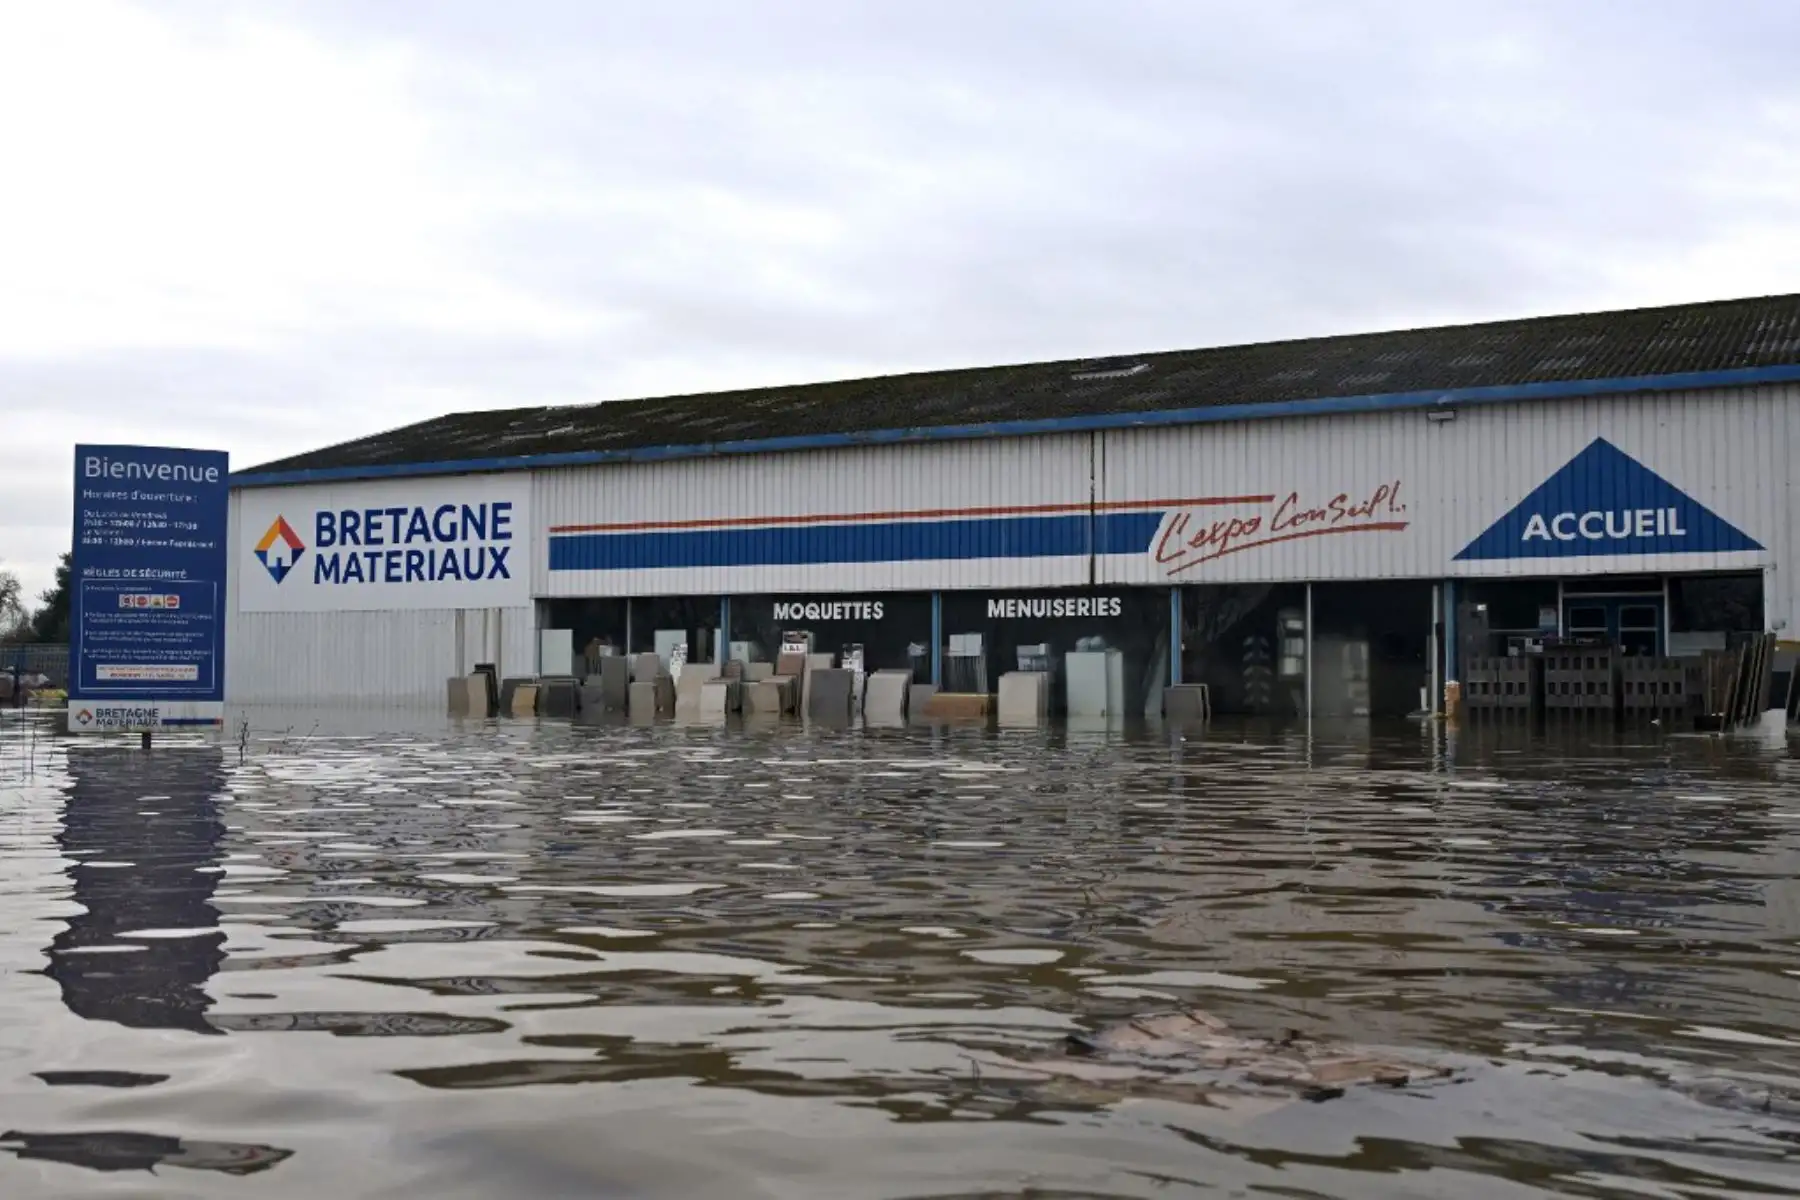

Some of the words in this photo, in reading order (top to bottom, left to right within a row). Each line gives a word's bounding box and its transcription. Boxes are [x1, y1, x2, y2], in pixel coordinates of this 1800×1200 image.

[85, 457, 219, 482] Bienvenue
[83, 490, 128, 500] Horaires
[316, 502, 512, 547] BRETAGNE
[1521, 508, 1687, 541] ACCUEIL
[314, 546, 511, 584] MATERIAUX
[773, 601, 884, 620] MOQUETTES
[988, 597, 1121, 618] MENUISERIES
[95, 707, 159, 718] BRETAGNE
[95, 718, 159, 727] MATERIAUX
